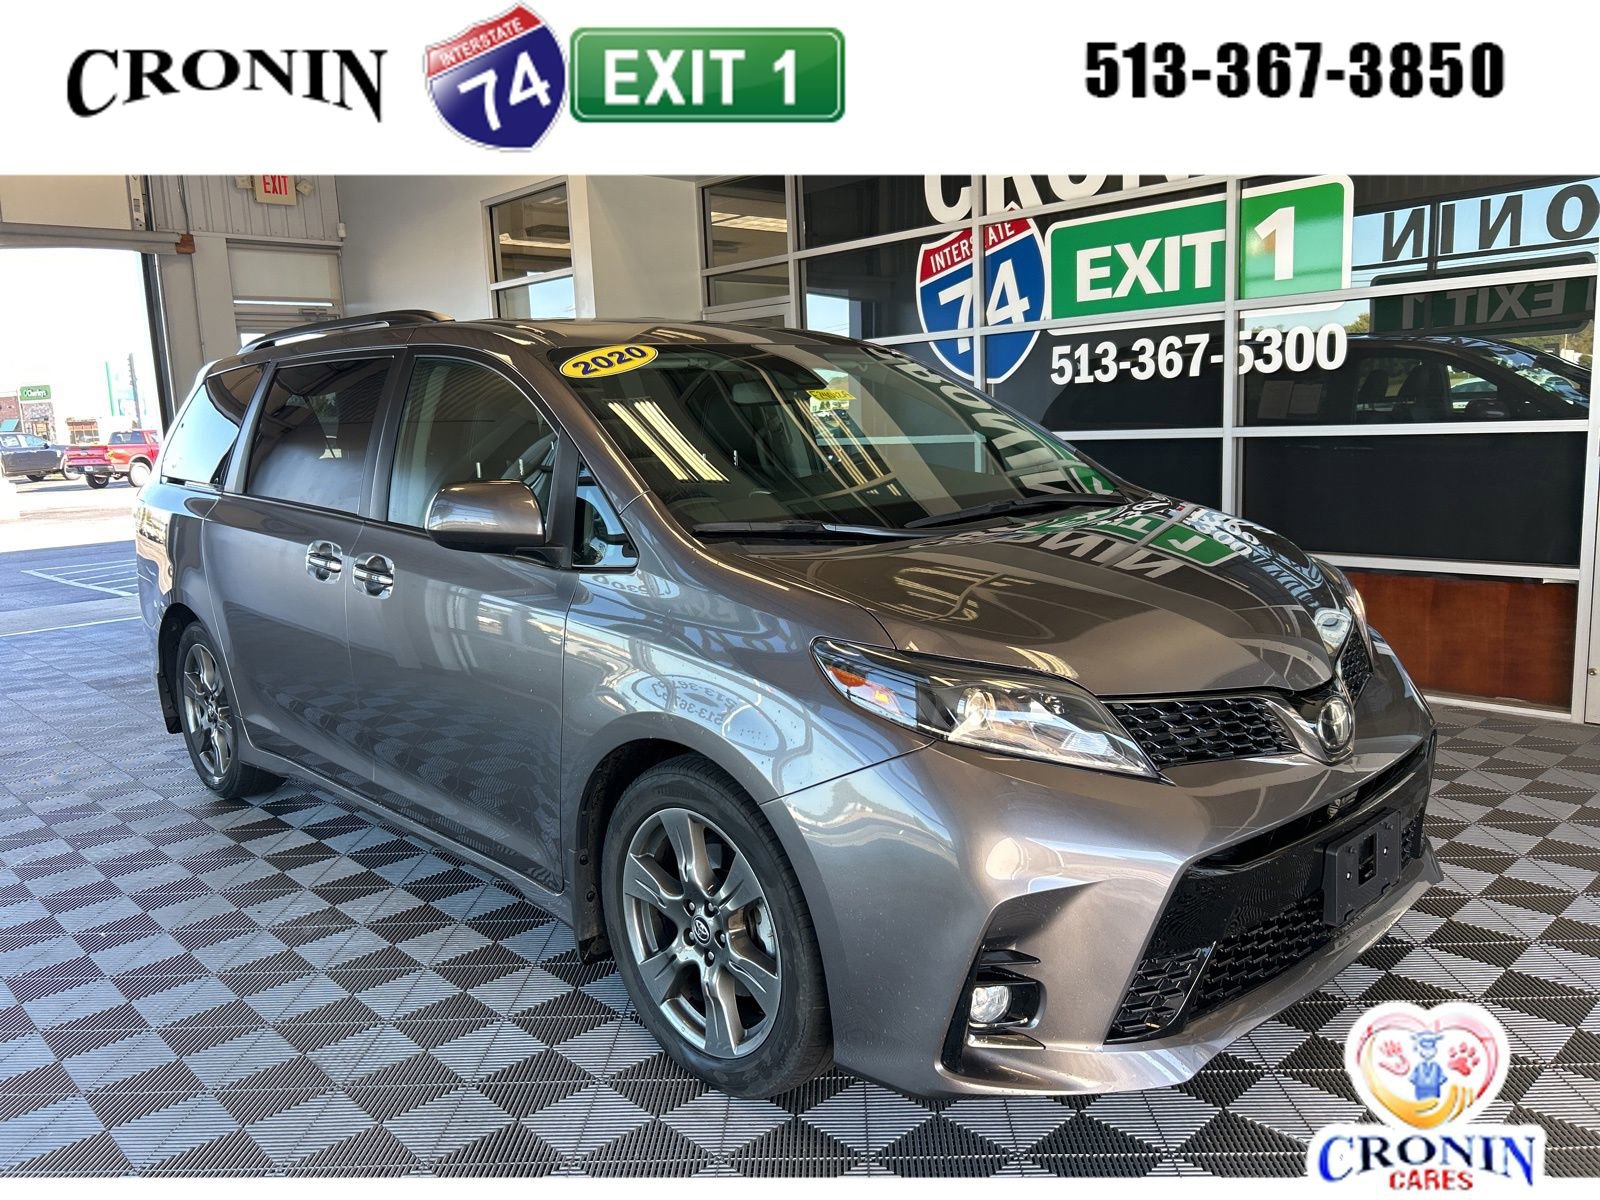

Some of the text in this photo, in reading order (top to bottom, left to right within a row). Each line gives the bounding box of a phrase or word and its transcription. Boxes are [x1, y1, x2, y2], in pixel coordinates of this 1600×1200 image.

[262, 174, 289, 195] EXIT
[1075, 206, 1296, 303] EXIT 1
[938, 258, 1031, 355] 74
[571, 345, 649, 376] 2020
[1050, 322, 1348, 386] 513-367-5300
